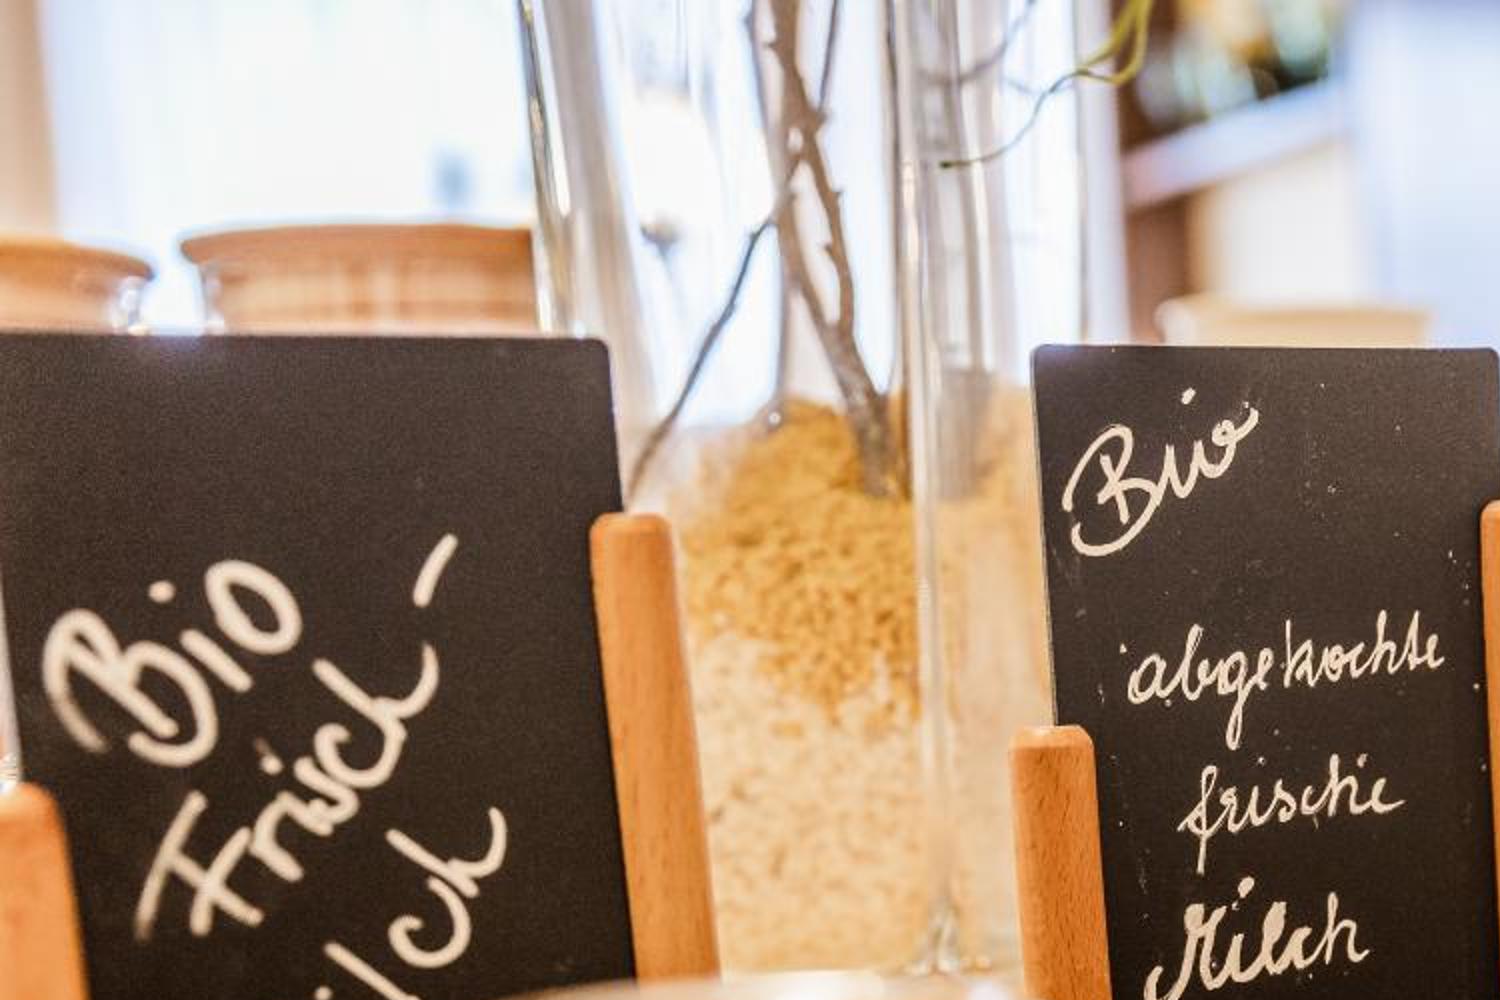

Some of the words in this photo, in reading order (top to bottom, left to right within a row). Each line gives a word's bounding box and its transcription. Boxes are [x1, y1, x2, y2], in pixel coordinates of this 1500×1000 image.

[1062, 388, 1258, 557] Bio
[43, 558, 303, 768] Bio
[134, 533, 459, 942] Frisch-
[1126, 610, 1446, 751] abgekochte
[1177, 753, 1406, 875] frische
